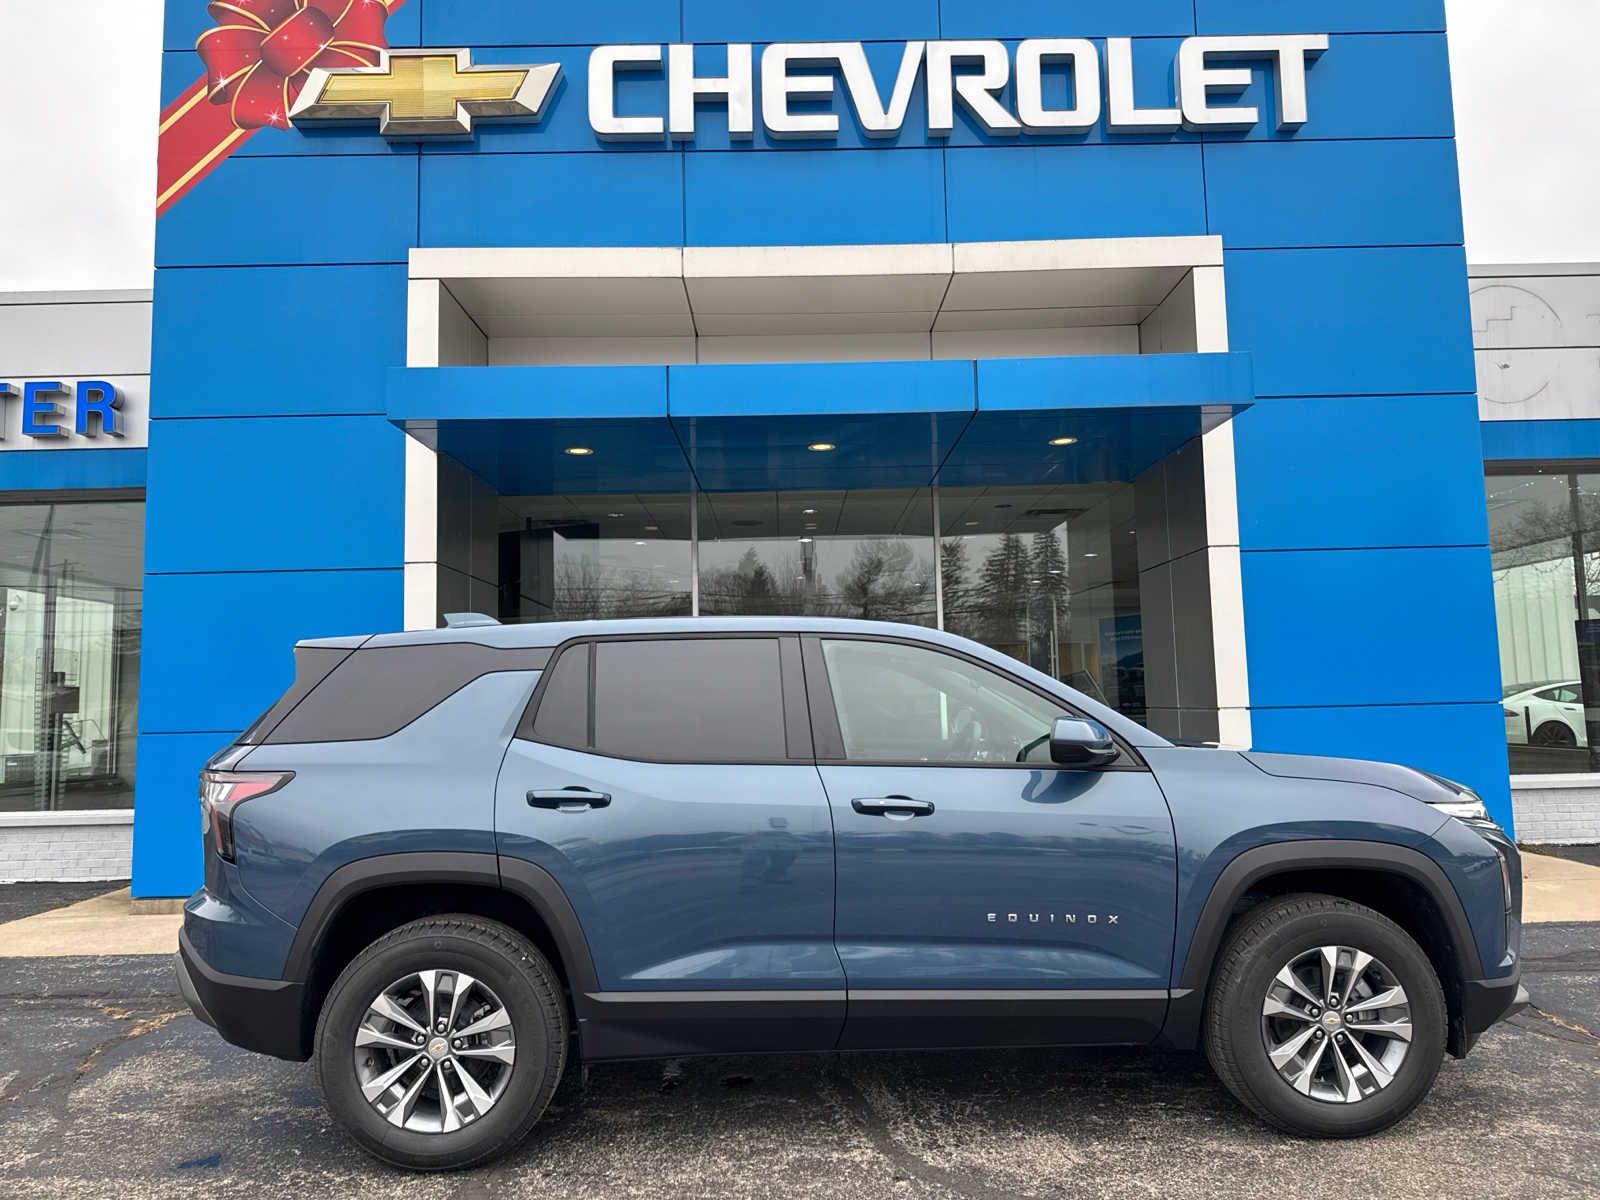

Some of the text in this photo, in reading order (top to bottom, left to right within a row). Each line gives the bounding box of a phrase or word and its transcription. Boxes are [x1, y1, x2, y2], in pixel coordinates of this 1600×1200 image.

[588, 34, 1329, 141] CHEVROLET
[0, 380, 124, 437] ER
[986, 912, 1119, 925] EQUINOX
